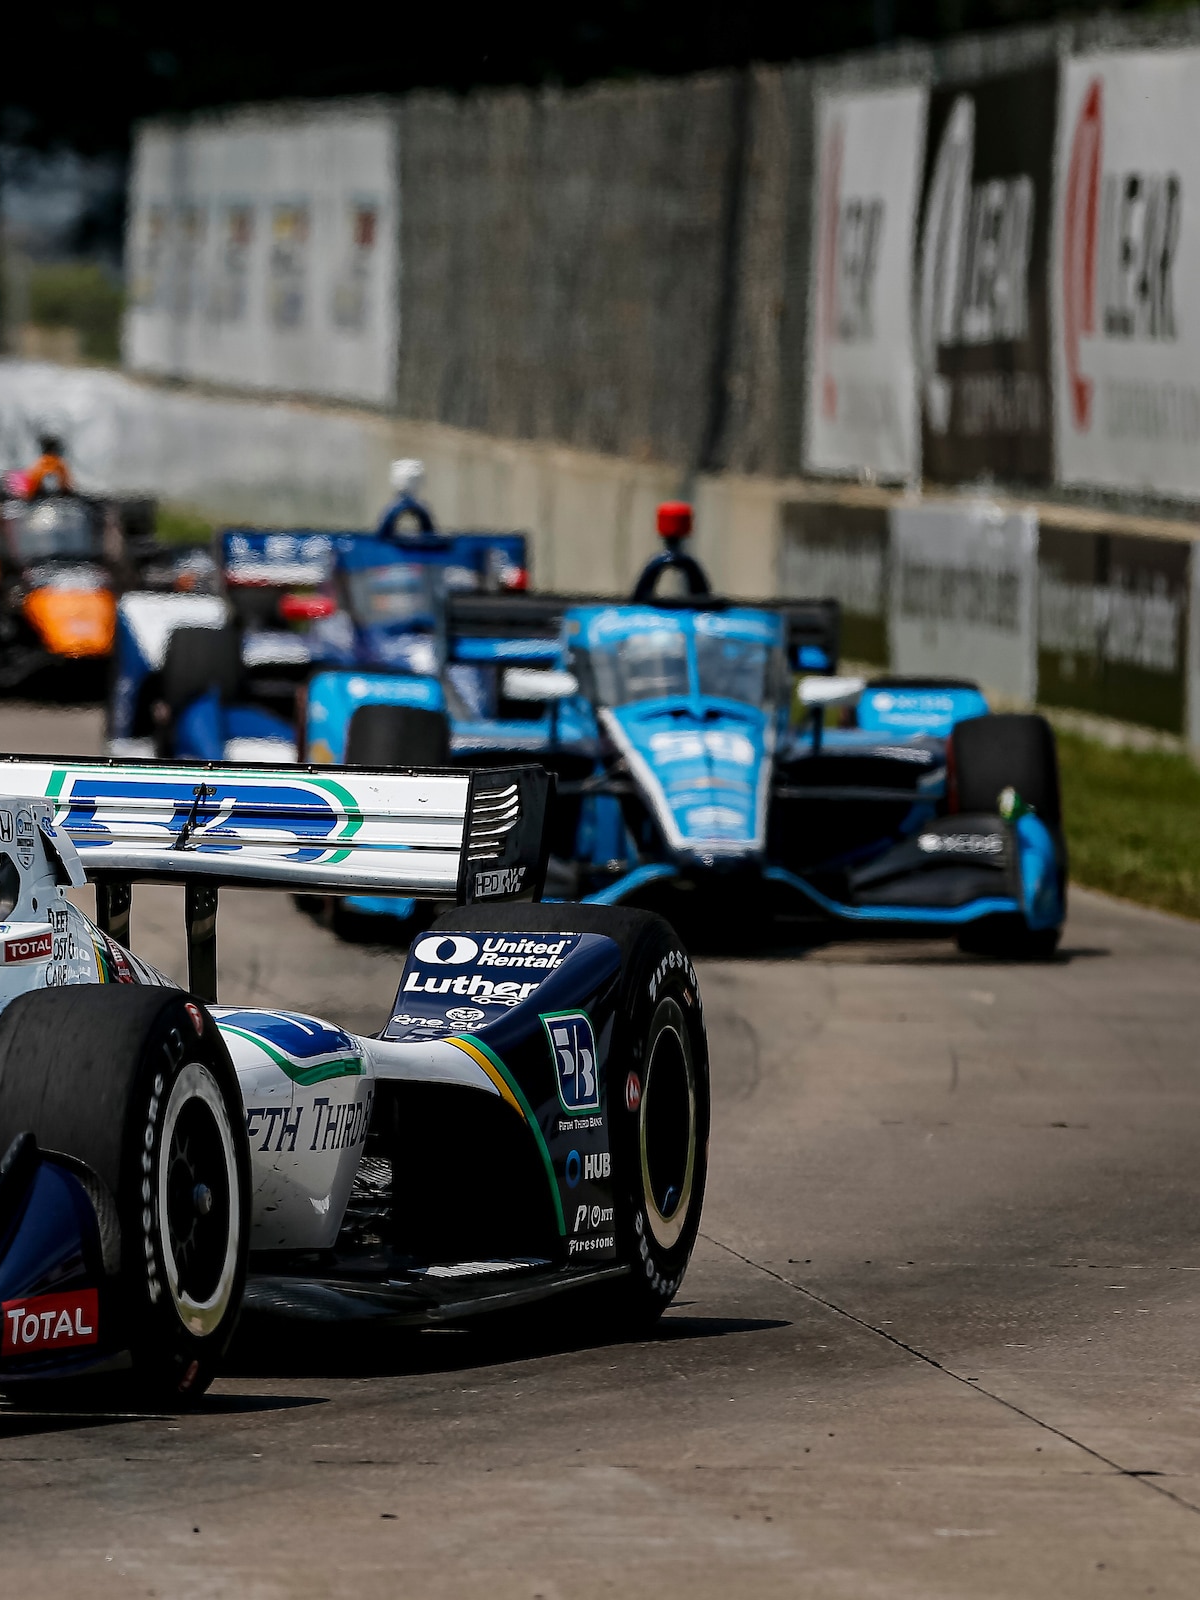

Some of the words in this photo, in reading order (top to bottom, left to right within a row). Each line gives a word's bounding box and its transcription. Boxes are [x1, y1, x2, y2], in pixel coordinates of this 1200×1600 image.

[7, 938, 52, 957] TOTAL
[53, 937, 68, 961] OST
[482, 937, 567, 955] United
[477, 953, 565, 969] Rentals
[246, 1106, 304, 1152] FTH
[584, 1152, 611, 1180] HUB
[600, 1207, 614, 1222] NTT
[568, 1236, 614, 1256] Firestone
[7, 1307, 93, 1345] TOTAL
